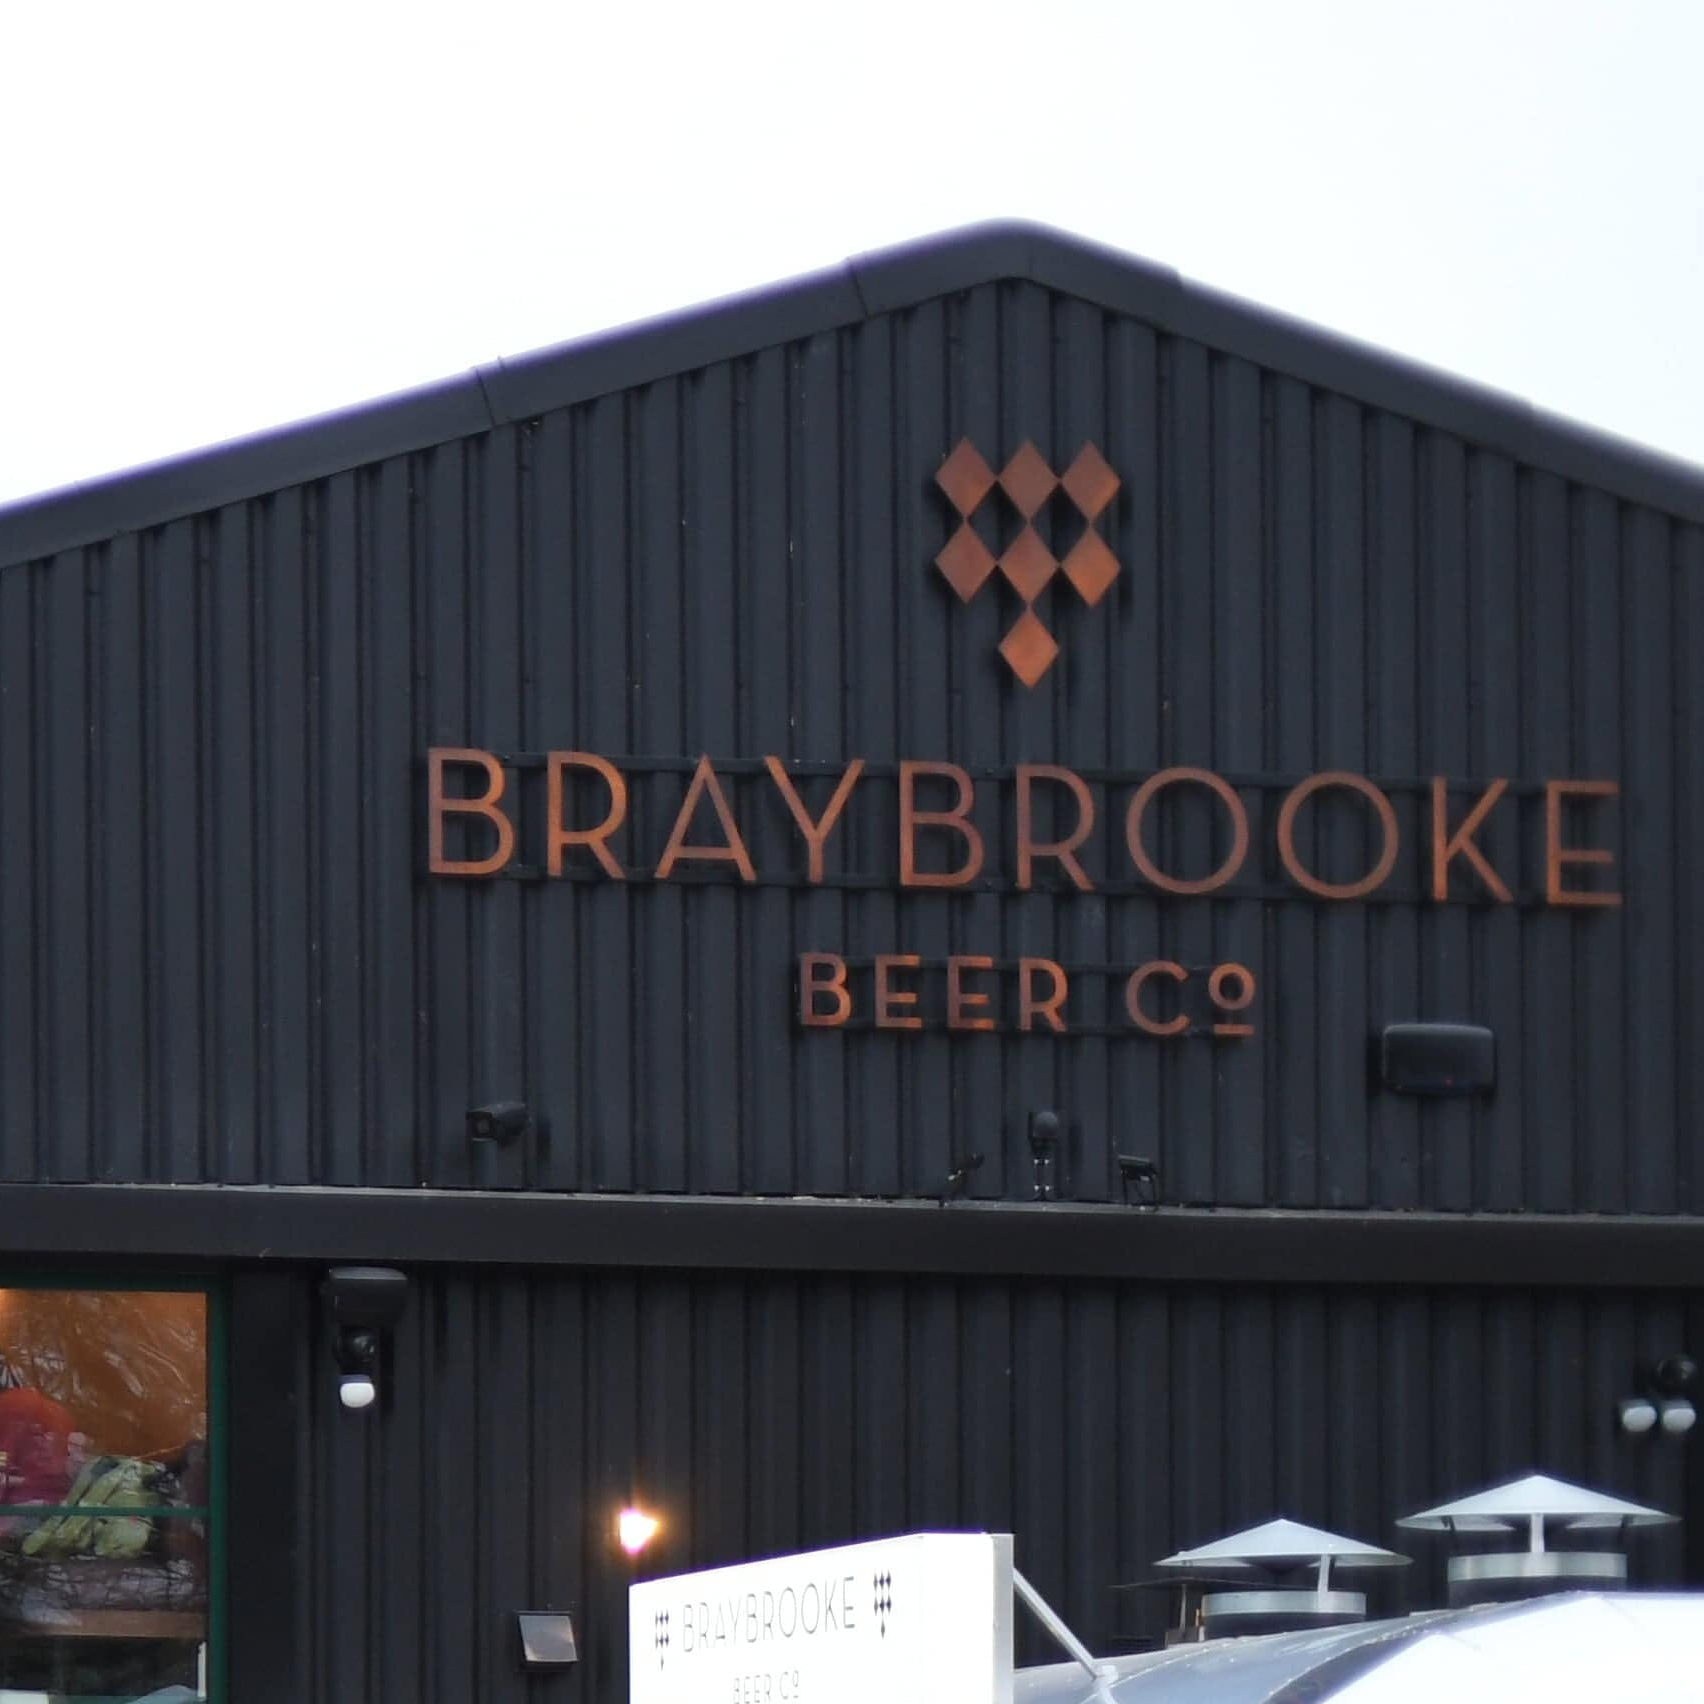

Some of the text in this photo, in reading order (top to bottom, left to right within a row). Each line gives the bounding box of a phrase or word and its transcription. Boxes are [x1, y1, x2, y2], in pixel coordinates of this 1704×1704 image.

[426, 747, 1623, 908] BRAYBROOKE
[799, 952, 1068, 1032] BEER
[682, 1576, 856, 1653] BRAYBROOKE
